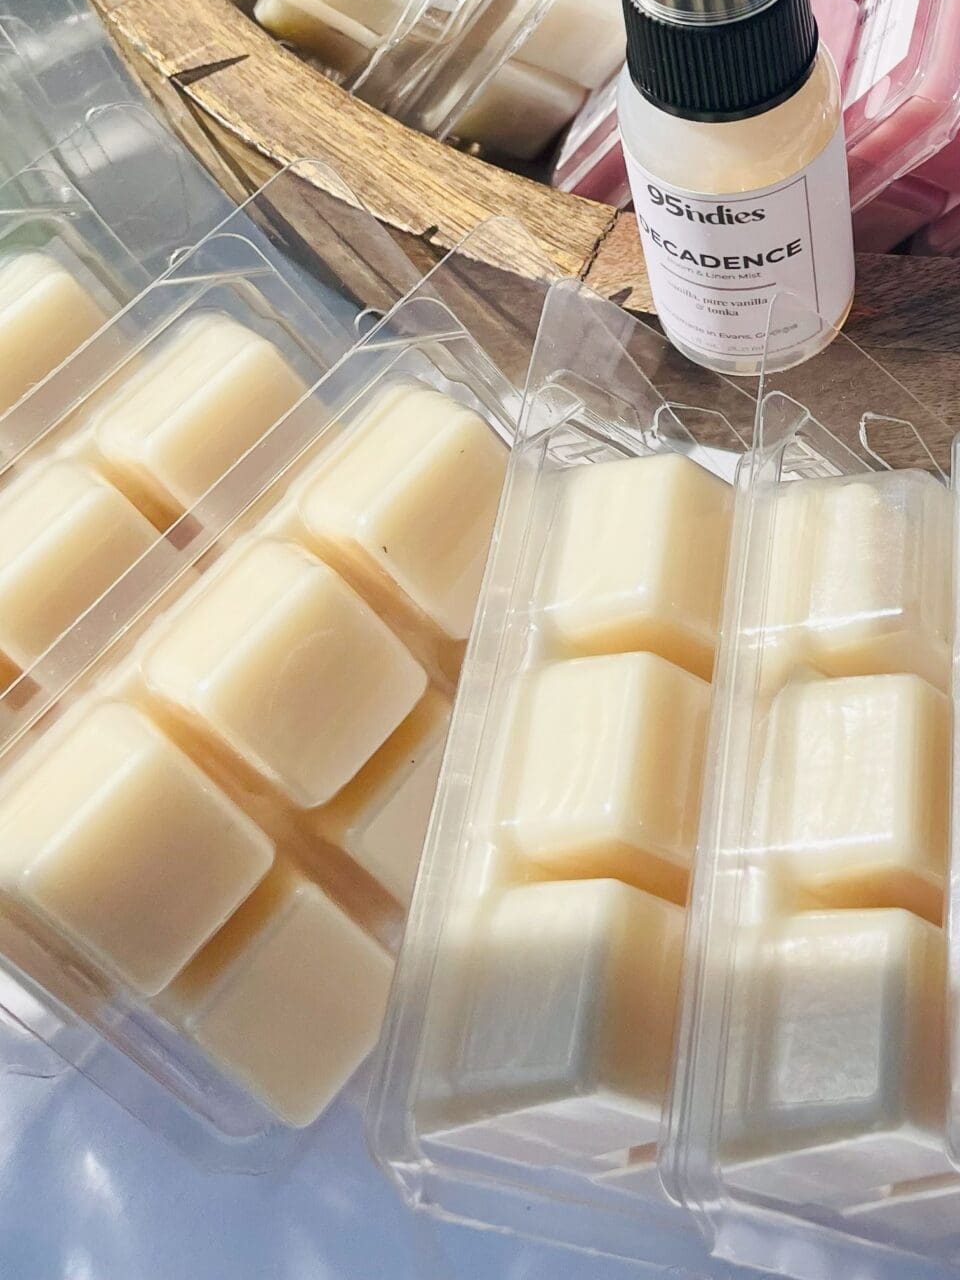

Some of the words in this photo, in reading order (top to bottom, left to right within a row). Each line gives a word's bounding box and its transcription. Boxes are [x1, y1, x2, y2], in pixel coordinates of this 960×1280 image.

[647, 184, 766, 226] 95indies
[639, 214, 803, 270] DECADENCE
[707, 306, 740, 318] tonka
[730, 295, 768, 307] vanilla
